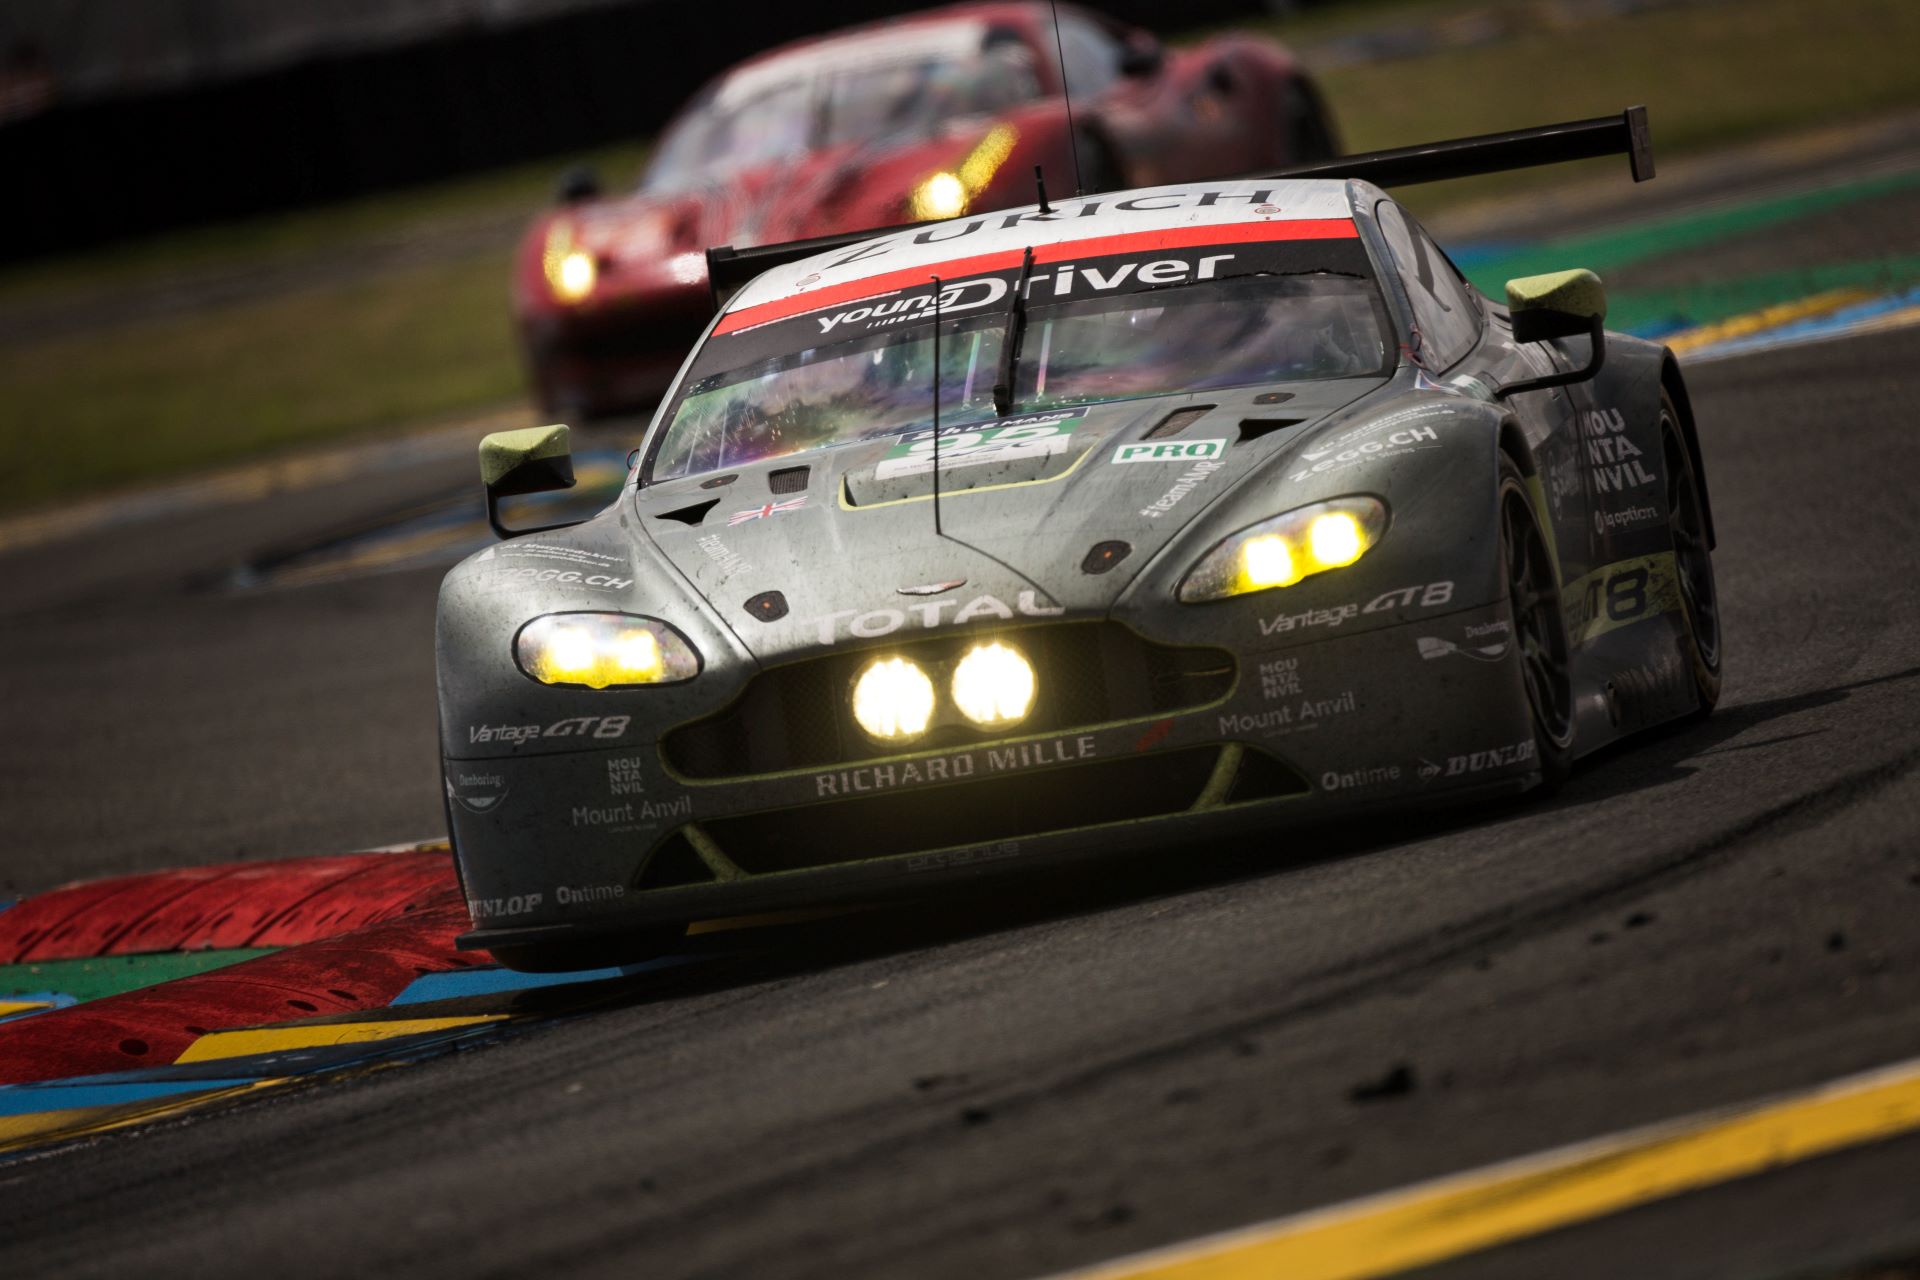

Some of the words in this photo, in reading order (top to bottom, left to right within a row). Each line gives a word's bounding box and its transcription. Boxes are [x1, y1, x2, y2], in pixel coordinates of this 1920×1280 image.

[823, 190, 1276, 270] ZURICH
[818, 287, 964, 334] young
[1583, 408, 1625, 436] MOU
[1121, 442, 1217, 460] PRO
[1587, 435, 1643, 465] NTA
[1592, 460, 1656, 494] NVIL
[802, 590, 1066, 645] TOTAL
[1258, 602, 1357, 637] Vantage
[1361, 581, 1455, 615] GT8
[1259, 657, 1299, 675] MOU
[1218, 705, 1293, 735] Mount
[1300, 691, 1355, 721] Anvil
[469, 724, 540, 745] Vantage
[543, 715, 631, 738] GT8
[607, 756, 641, 771] MOU
[608, 769, 642, 783] NTA
[816, 752, 974, 797] RICHARD
[988, 736, 1097, 770] MILLE
[1321, 762, 1400, 791] Ontime
[610, 782, 646, 796] NVIL
[572, 802, 634, 827] Mount
[640, 795, 693, 820] Anvil
[556, 882, 624, 905] Ontime
